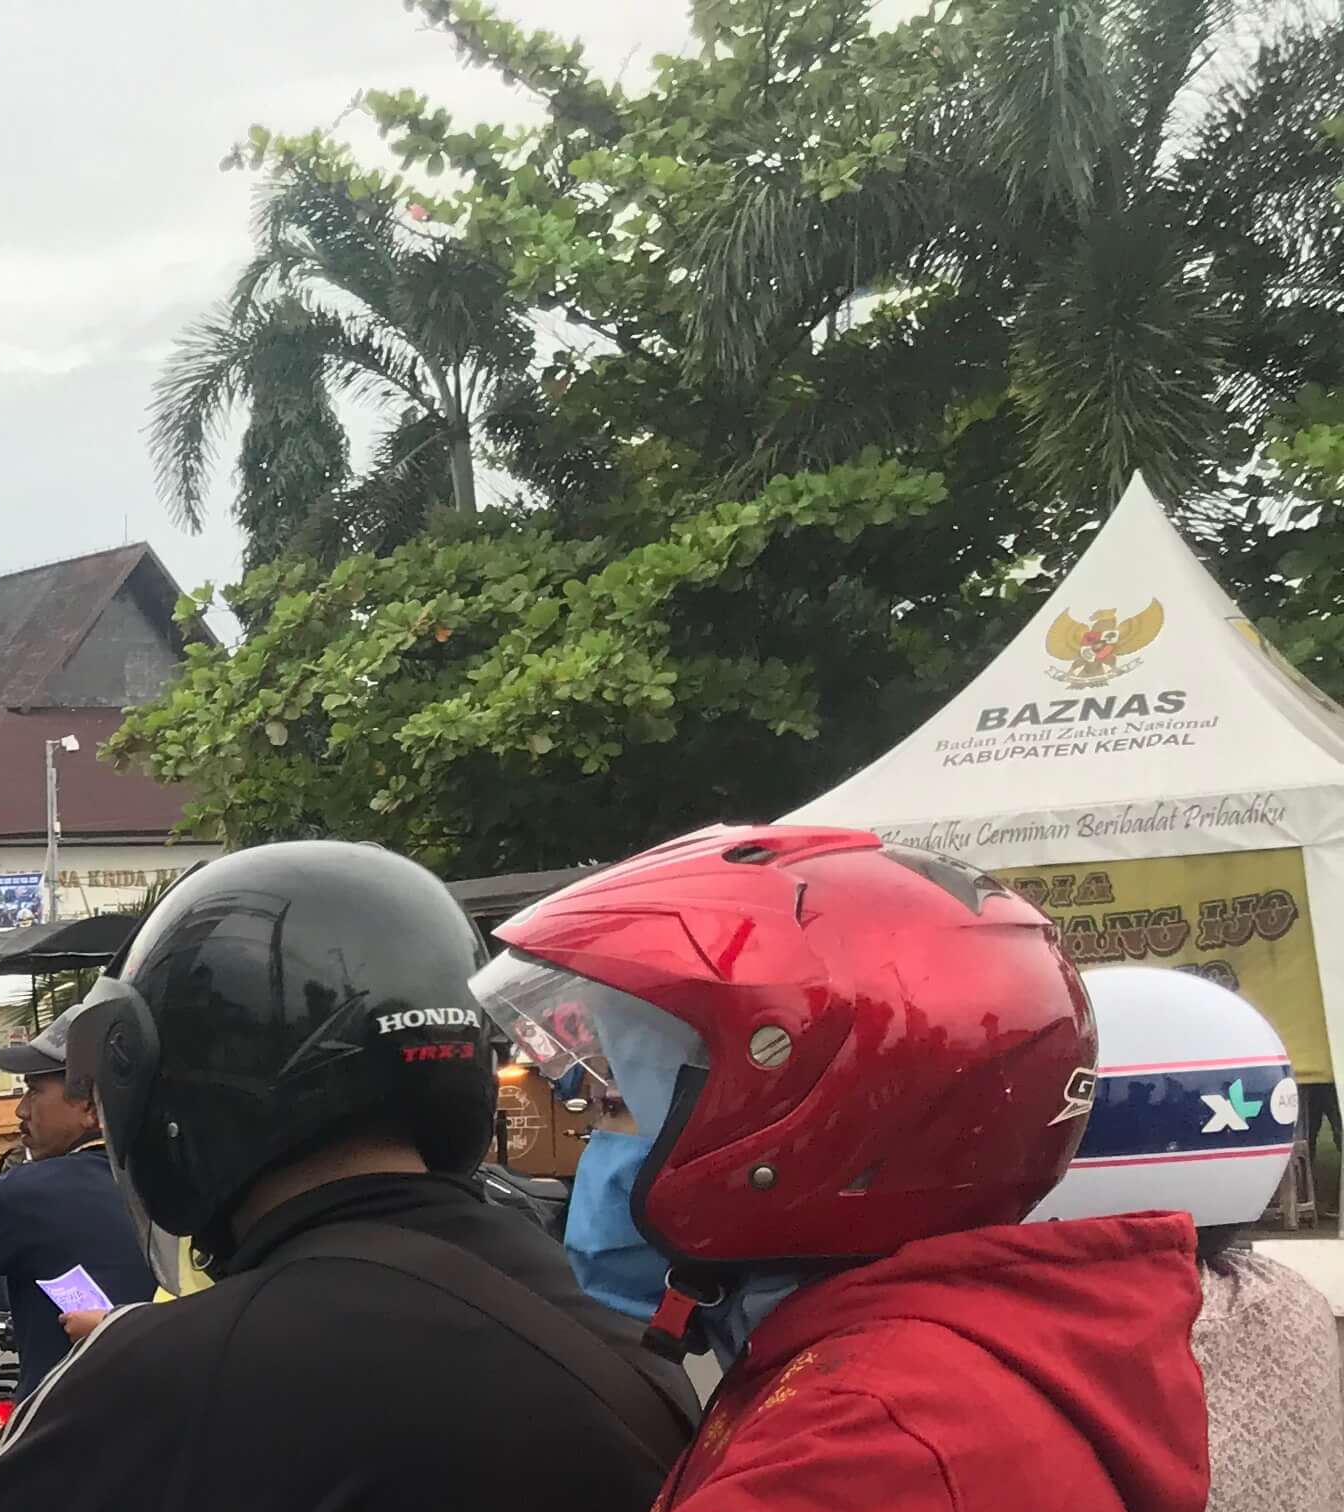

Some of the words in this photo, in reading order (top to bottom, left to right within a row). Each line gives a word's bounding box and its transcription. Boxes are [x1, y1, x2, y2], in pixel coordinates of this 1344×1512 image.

[976, 690, 1188, 733] BAZNAS
[935, 735, 998, 754] Badan
[1001, 727, 1053, 746] Amil
[1055, 721, 1118, 741] Zakat
[1122, 715, 1220, 736] Nasional
[942, 742, 1090, 768] KABUPATEN
[1094, 732, 1197, 754] KENDAL
[975, 819, 1071, 847] Cerminan
[1076, 805, 1178, 842] Beribadat
[1183, 793, 1288, 831] Pribadiku
[87, 869, 148, 888] KRIDA
[1004, 872, 1115, 908] DIA
[1055, 904, 1191, 964] ANG
[1196, 888, 1300, 951] IJO
[375, 1007, 481, 1034] HONDA
[1200, 1078, 1264, 1133] XL
